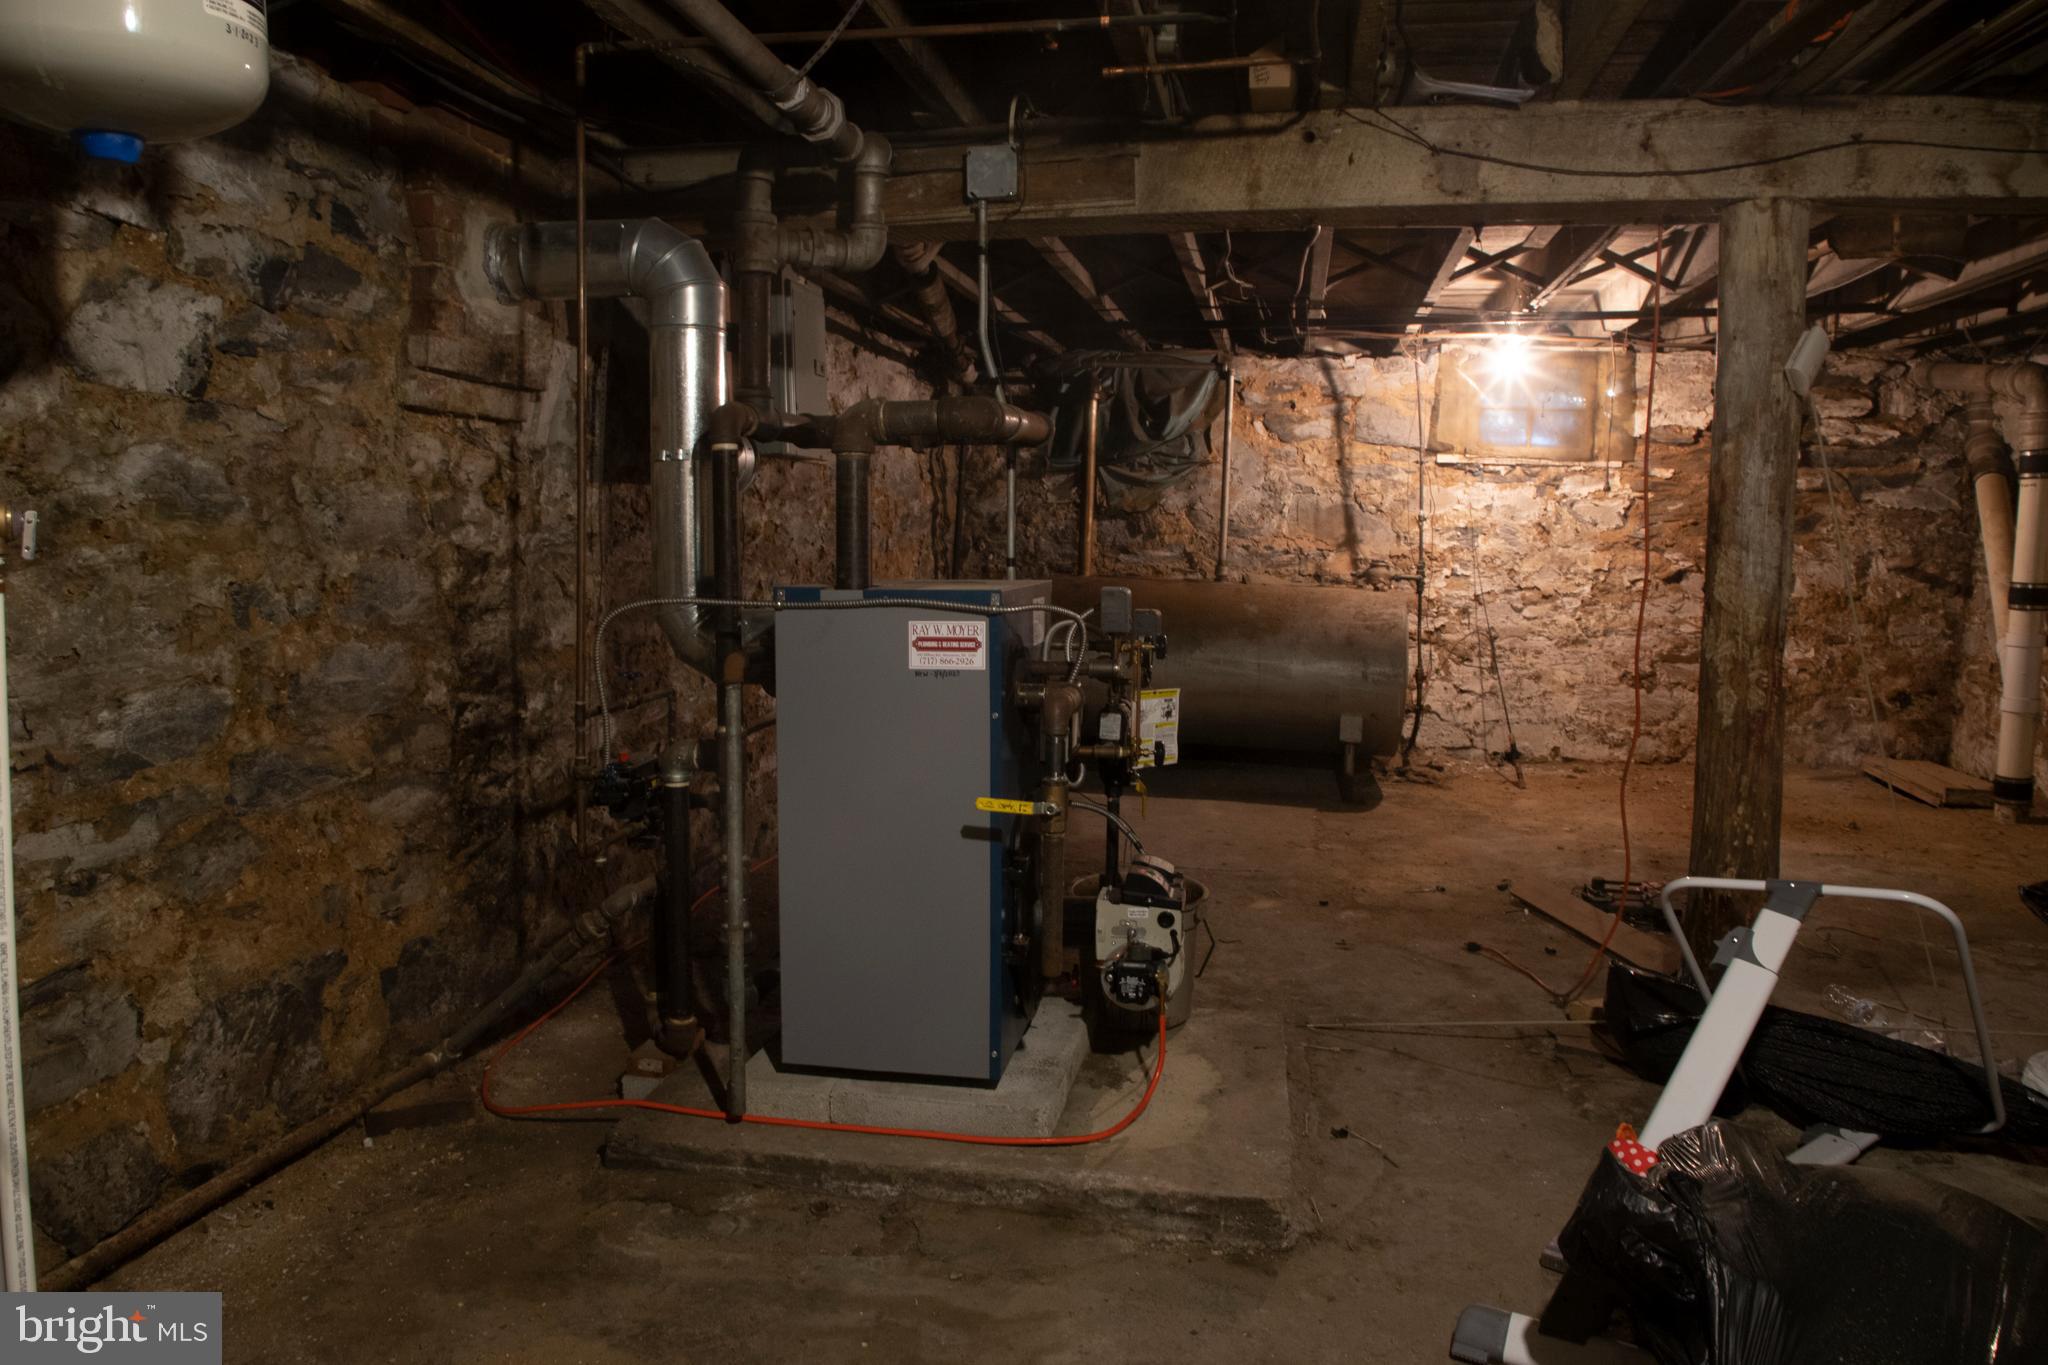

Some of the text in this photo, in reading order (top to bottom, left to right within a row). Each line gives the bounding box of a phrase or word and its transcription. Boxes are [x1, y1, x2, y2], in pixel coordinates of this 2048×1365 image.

[912, 624, 979, 636] RAY W. MOYER
[920, 657, 975, 665] (717) 866-2926
